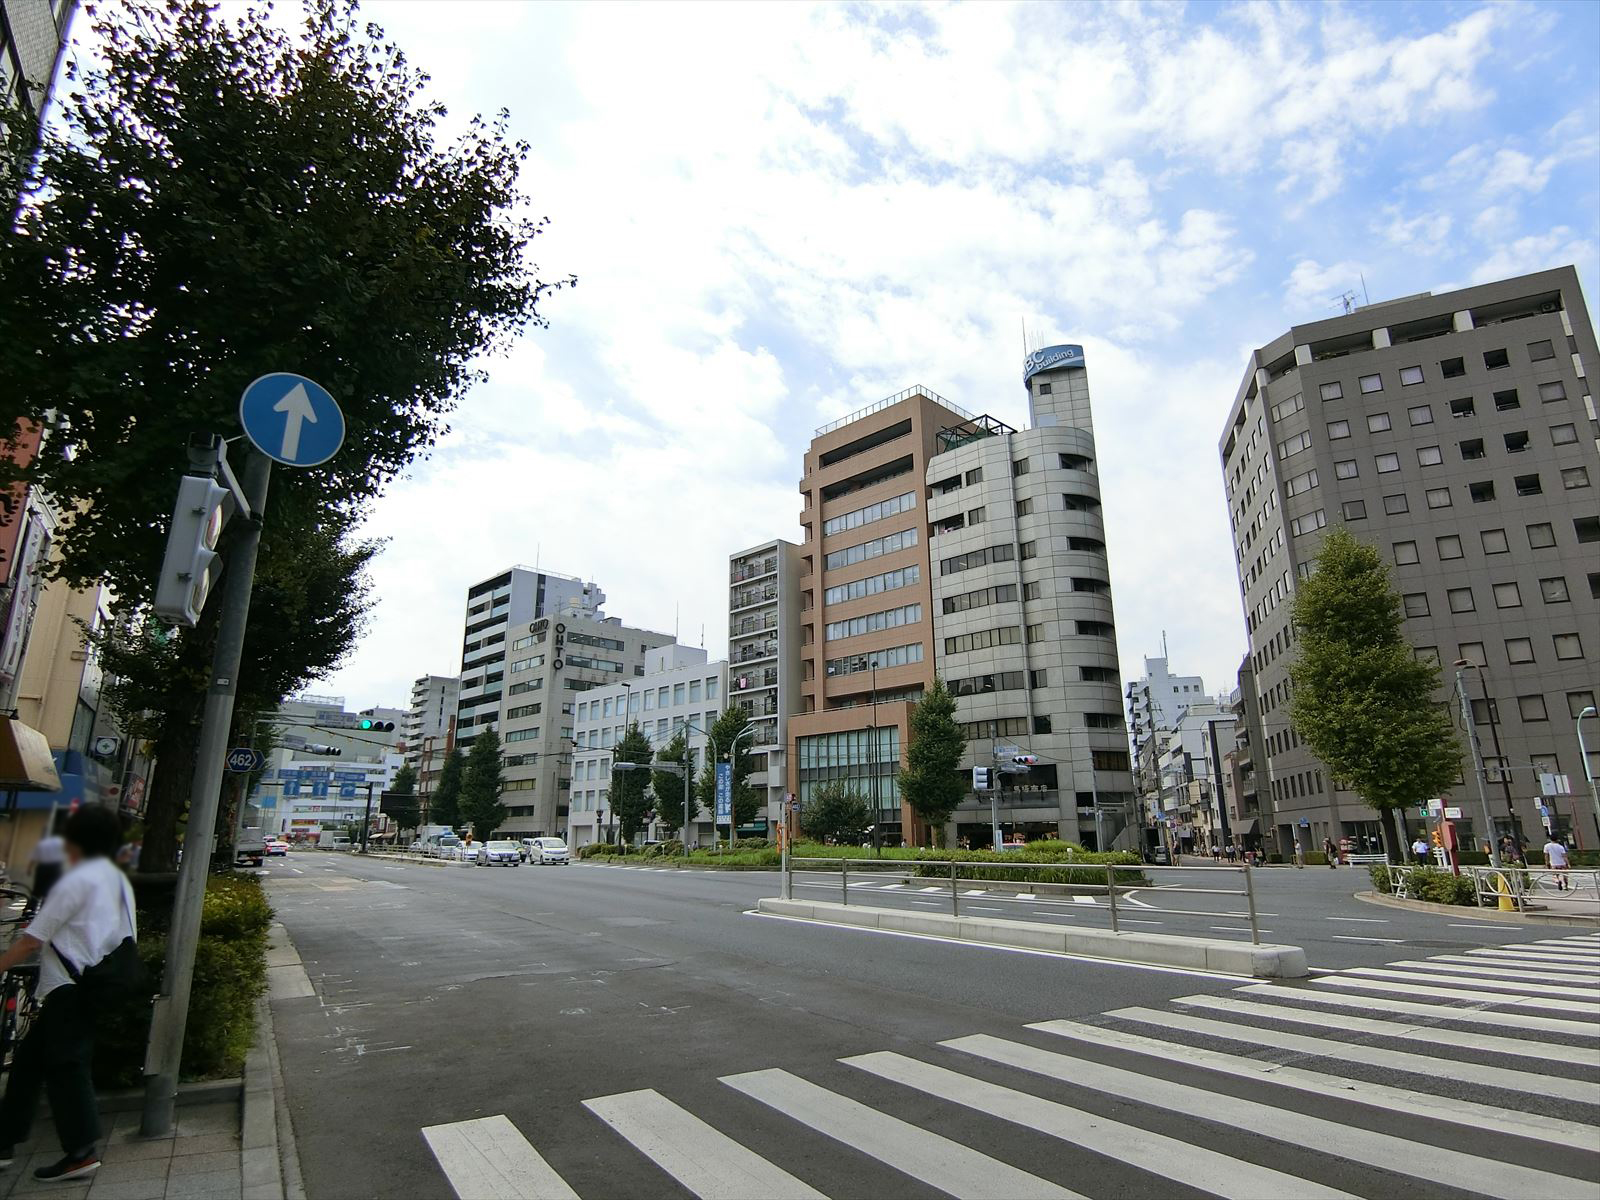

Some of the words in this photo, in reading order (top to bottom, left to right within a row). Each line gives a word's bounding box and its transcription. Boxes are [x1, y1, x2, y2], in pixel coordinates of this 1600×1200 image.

[1036, 350, 1074, 370] building
[553, 623, 565, 669] OHTO
[230, 754, 252, 767] 462
